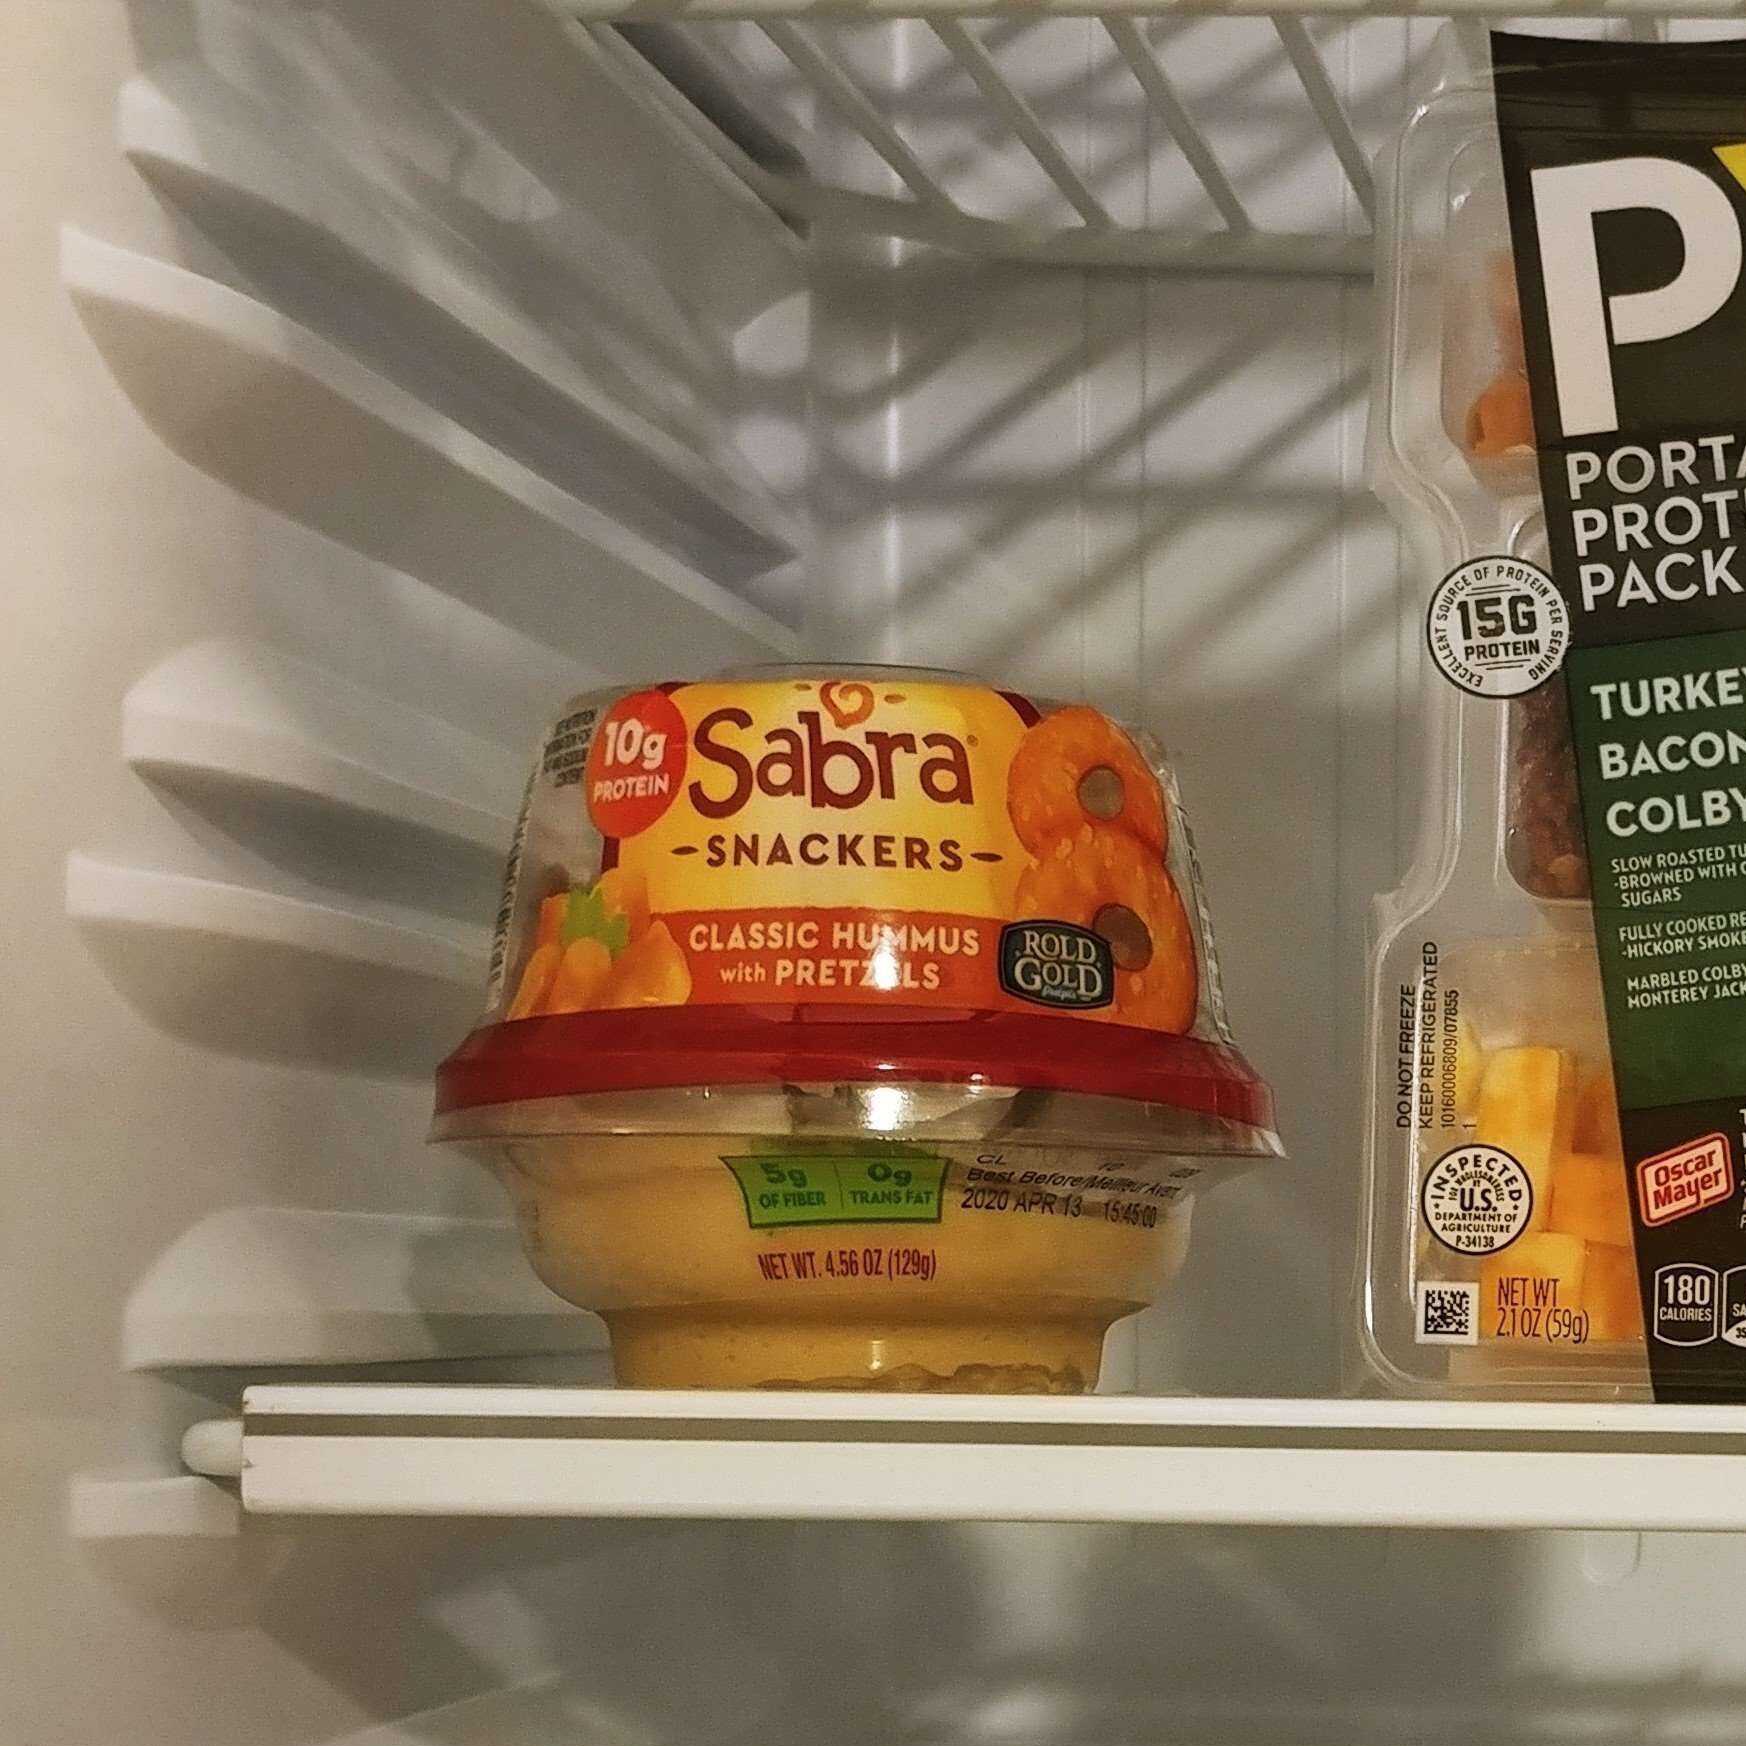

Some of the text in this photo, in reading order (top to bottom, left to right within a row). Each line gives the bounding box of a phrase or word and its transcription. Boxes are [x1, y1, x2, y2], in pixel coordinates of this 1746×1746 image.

[1579, 546, 1744, 612] PACK
[1435, 565, 1563, 687] EXCELLENT SOURCE OF PROTEIN PER SERVING
[1456, 595, 1537, 640] 15G
[1464, 639, 1540, 661] PROTEIN
[604, 718, 667, 770] 10g
[688, 707, 976, 819] Sabra
[593, 773, 670, 803] PROTEIN
[707, 834, 963, 871] SNACKERS
[1611, 856, 1651, 873] SLOW
[1657, 847, 1725, 869] ROASTED
[1698, 862, 1737, 879] WITH
[1621, 887, 1682, 907] SUGARS
[689, 922, 979, 955] CLASSIC HUMMUS
[1619, 922, 1662, 942] FULLY
[1666, 914, 1727, 936] COOKED
[1023, 930, 1096, 963] ROLD
[720, 959, 940, 990] with PRETZLS
[1015, 957, 1102, 998] GOLD
[1627, 969, 1698, 991] MARBLED
[1628, 987, 1709, 1009] MONTEREY
[1419, 941, 1438, 1129] KEEP REFRIGERATED
[1397, 984, 1415, 1128] DO NOT FREEZE
[765, 1162, 912, 1188] 5g 0g
[1431, 1154, 1522, 1201] INSPECTED
[1654, 1149, 1716, 1187] Oscar
[961, 1189, 1083, 1218] 2020 APR 13
[1460, 1188, 1498, 1212] U.S.
[1653, 1168, 1722, 1210] Mayer
[1435, 1213, 1518, 1222] DEPARTMENT OF
[1441, 1224, 1510, 1233] AGRICULTURE
[1456, 1235, 1495, 1248] P-34138
[758, 1249, 937, 1281] NET WT. 4.56 OZ (129g)
[1498, 1277, 1560, 1307] NET WT
[1663, 1275, 1711, 1305] 180
[1497, 1308, 1589, 1343] 2.1 OZ (59g)
[1660, 1307, 1712, 1321] CALORIES
